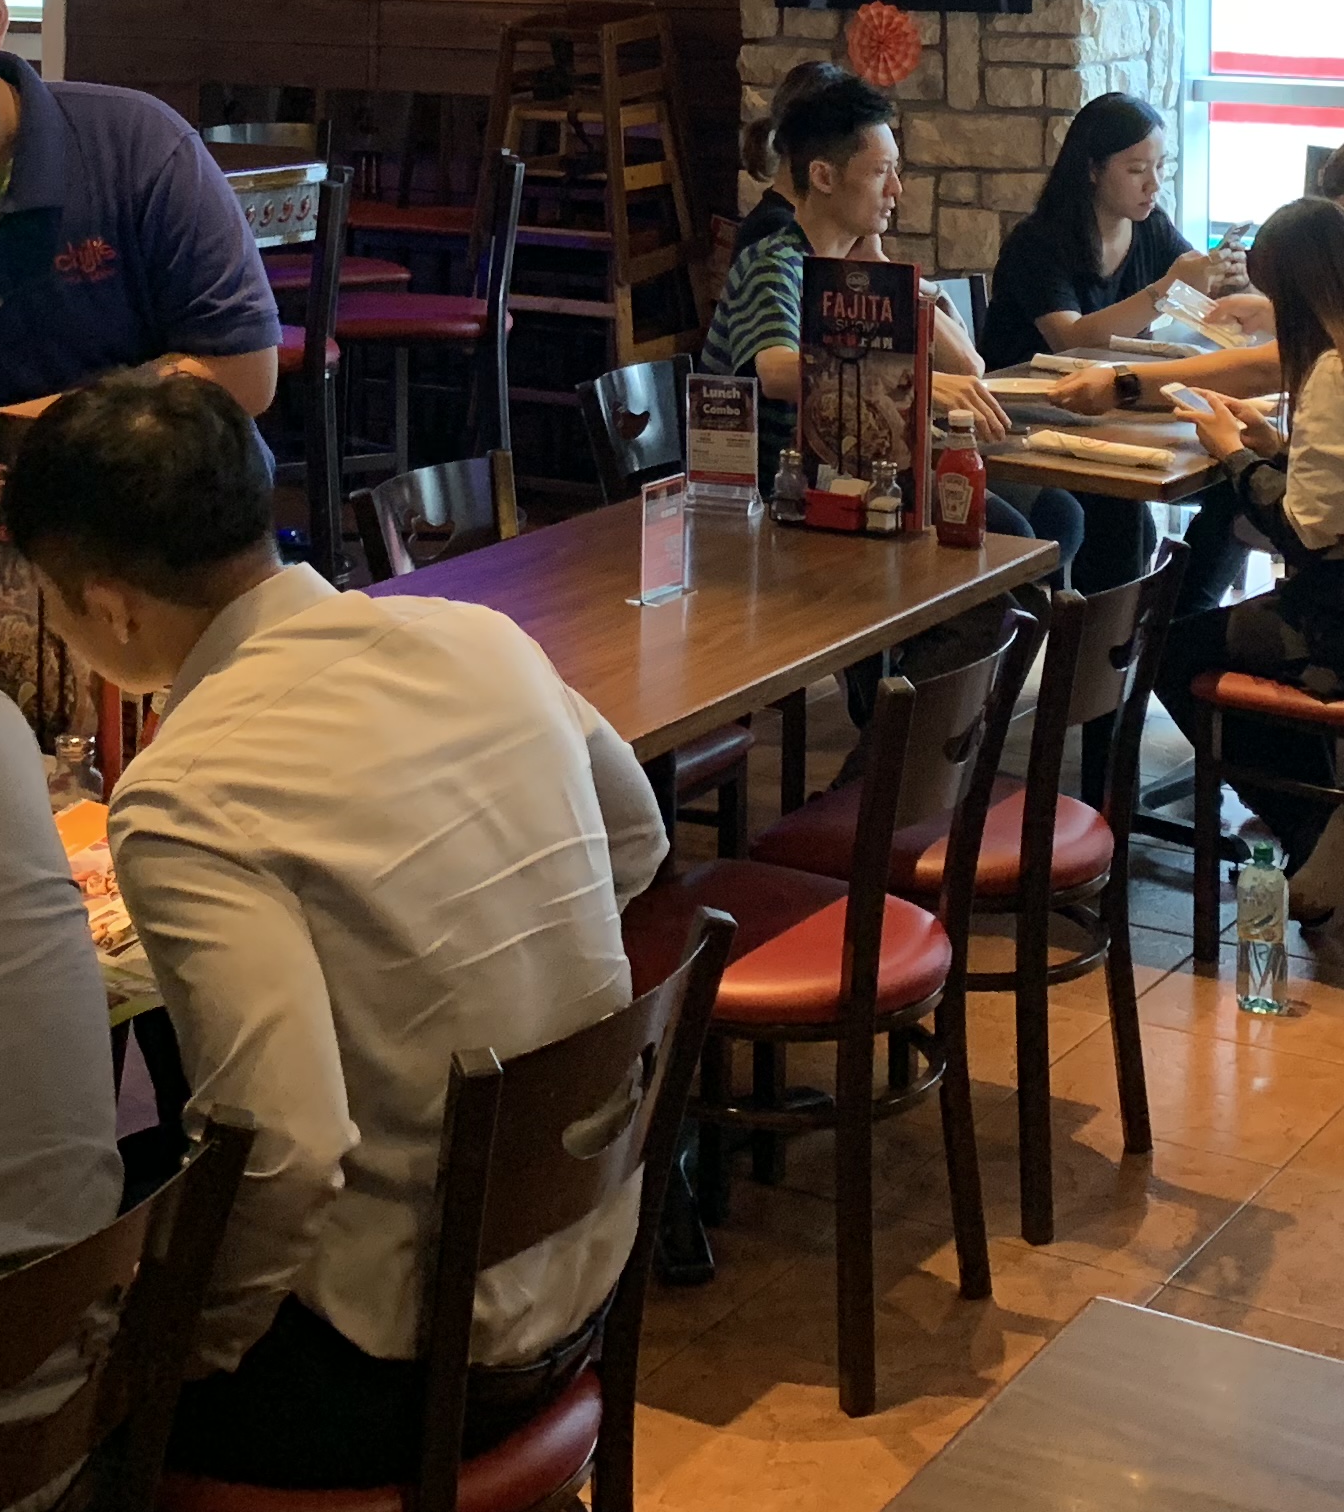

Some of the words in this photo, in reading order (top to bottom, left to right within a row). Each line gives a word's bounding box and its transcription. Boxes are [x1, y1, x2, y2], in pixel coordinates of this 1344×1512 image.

[822, 291, 893, 322] FAJITA
[702, 385, 741, 399] Lunch
[702, 403, 741, 416] Combo
